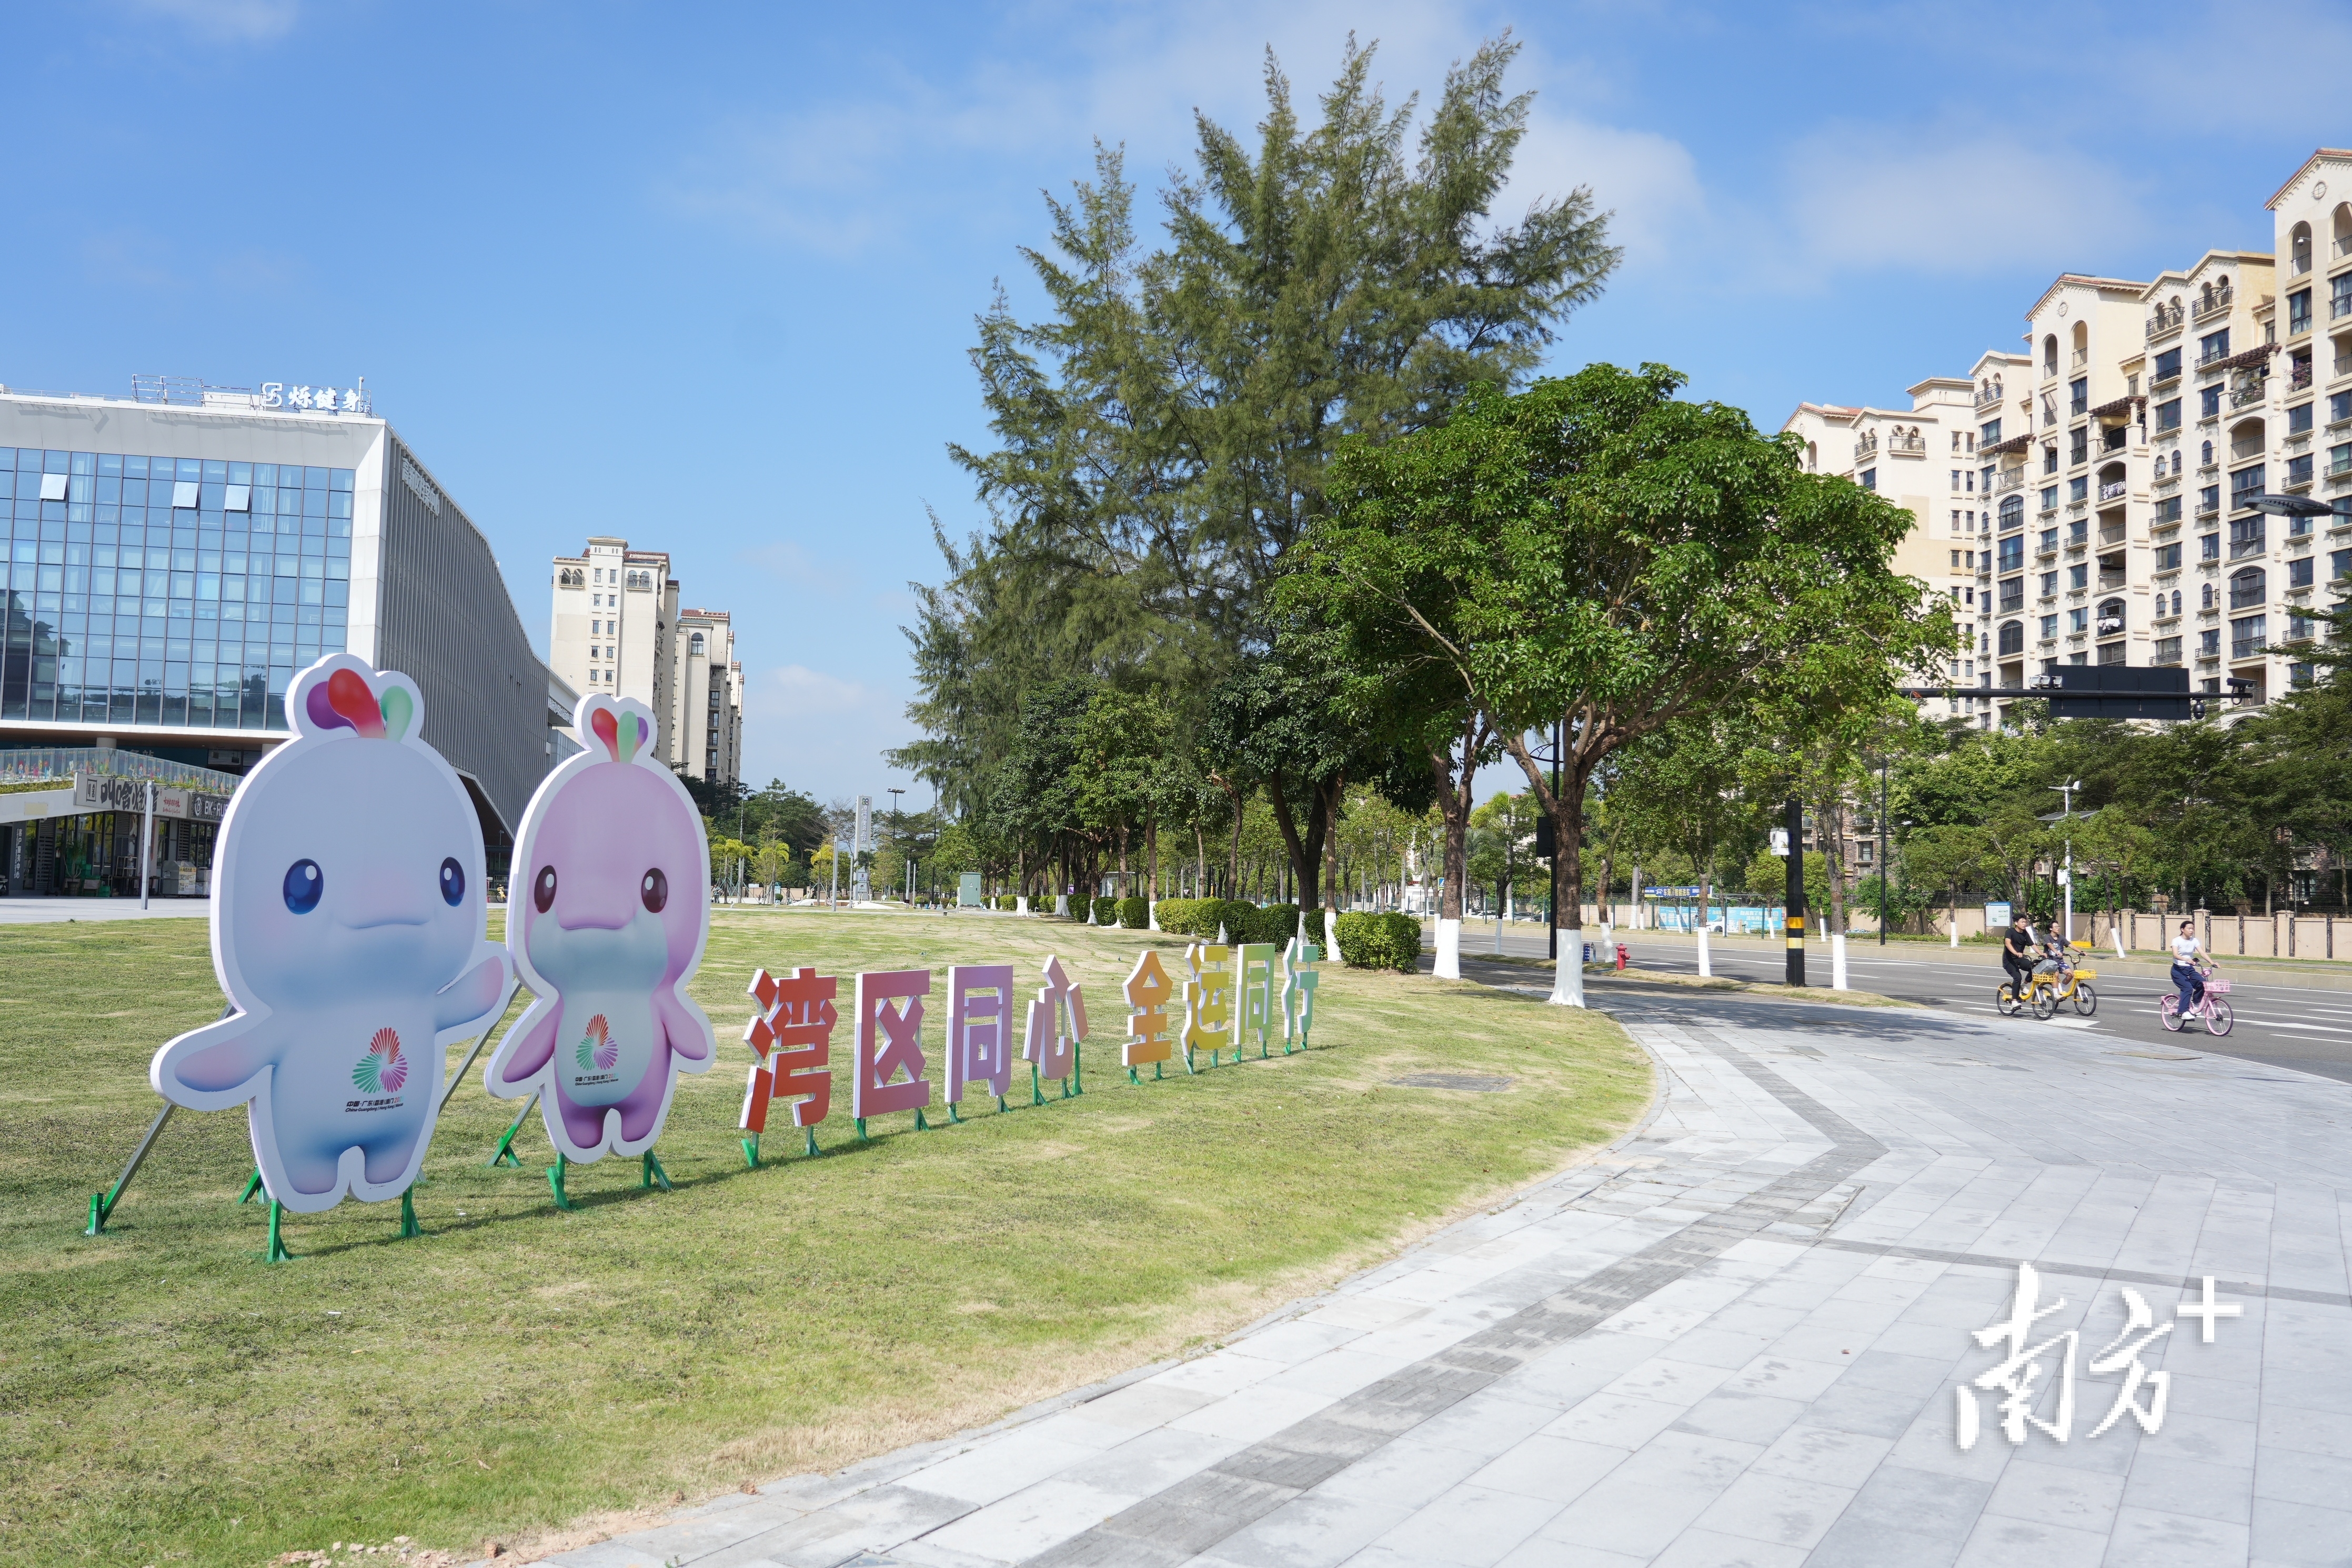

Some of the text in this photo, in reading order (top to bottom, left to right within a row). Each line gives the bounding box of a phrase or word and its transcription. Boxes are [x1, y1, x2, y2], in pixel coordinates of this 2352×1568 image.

[288, 386, 360, 412] 烁健身
[739, 937, 1320, 1133] 湾区同心 全运同行
